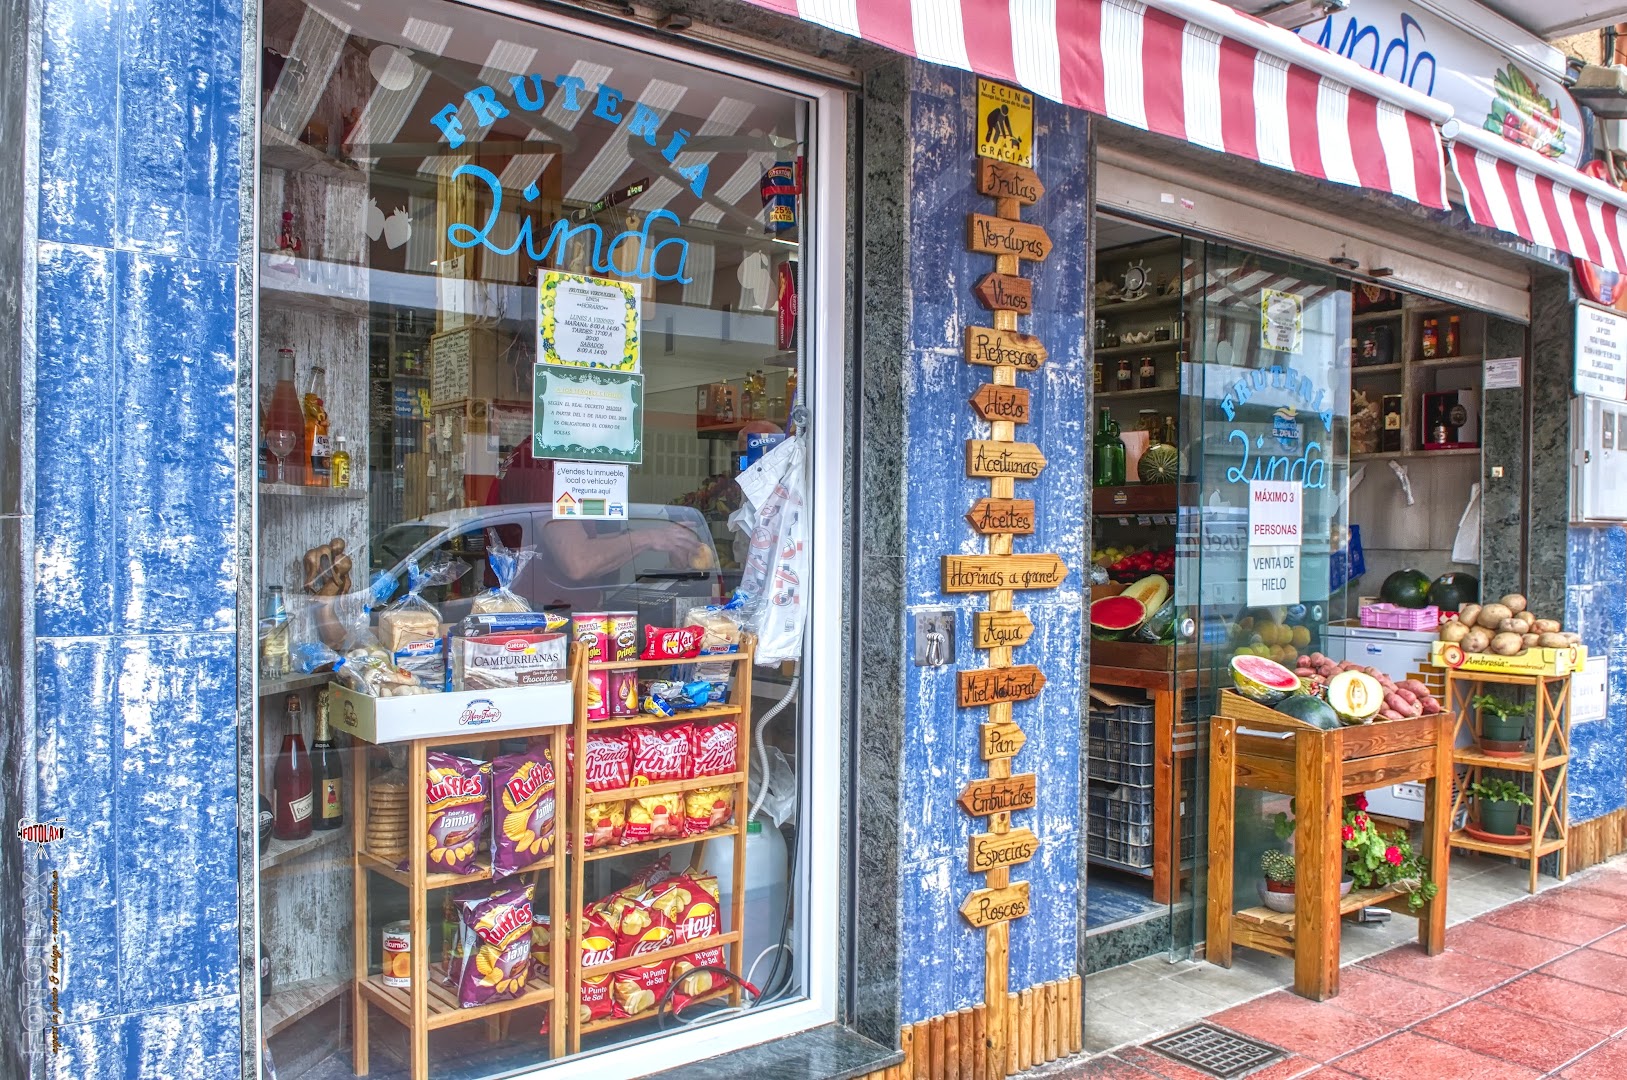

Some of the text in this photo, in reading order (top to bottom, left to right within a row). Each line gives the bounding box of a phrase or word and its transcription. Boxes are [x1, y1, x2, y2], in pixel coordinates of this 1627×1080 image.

[430, 73, 710, 198] FRUTERÍA
[981, 144, 1030, 164] GRACIAS
[987, 165, 1036, 201] Frutas
[448, 164, 692, 284] Linda
[978, 220, 1043, 257] Verduras
[991, 279, 1028, 309] Vinos
[976, 334, 1038, 367] Refrescos
[985, 390, 1024, 417] Hielo
[750, 437, 776, 448] OREO
[975, 444, 1038, 476] Aceitunas
[1226, 430, 1326, 489] Linda
[557, 468, 585, 476] ¿Vendes
[594, 469, 625, 478] inmueble,
[572, 487, 597, 495] Pregunta
[1254, 488, 1294, 502] MÁXIMO 3
[980, 504, 1030, 530] Aceites
[1254, 525, 1297, 535] PERSONAS
[951, 561, 1059, 588] Harinas a granel
[1253, 556, 1294, 570] VENTA DE
[1262, 578, 1286, 591] HIELO
[984, 617, 1022, 645] Agua
[474, 653, 559, 667] CAMPURRIANAS
[1465, 657, 1504, 666] Ambrosia
[965, 673, 1036, 703] Miel Natural
[595, 748, 626, 762] Santa
[655, 740, 688, 755] Santa
[989, 730, 1016, 755] Pan
[696, 743, 733, 771] Ana
[972, 784, 1033, 812] Embutidos
[440, 812, 475, 828] Jamón
[976, 841, 1030, 868] Especias
[977, 898, 1025, 923] Roscos
[477, 902, 533, 945] Ruffles
[582, 946, 614, 967] ay's
[702, 950, 719, 959] Punto
[650, 969, 666, 978] Punto
